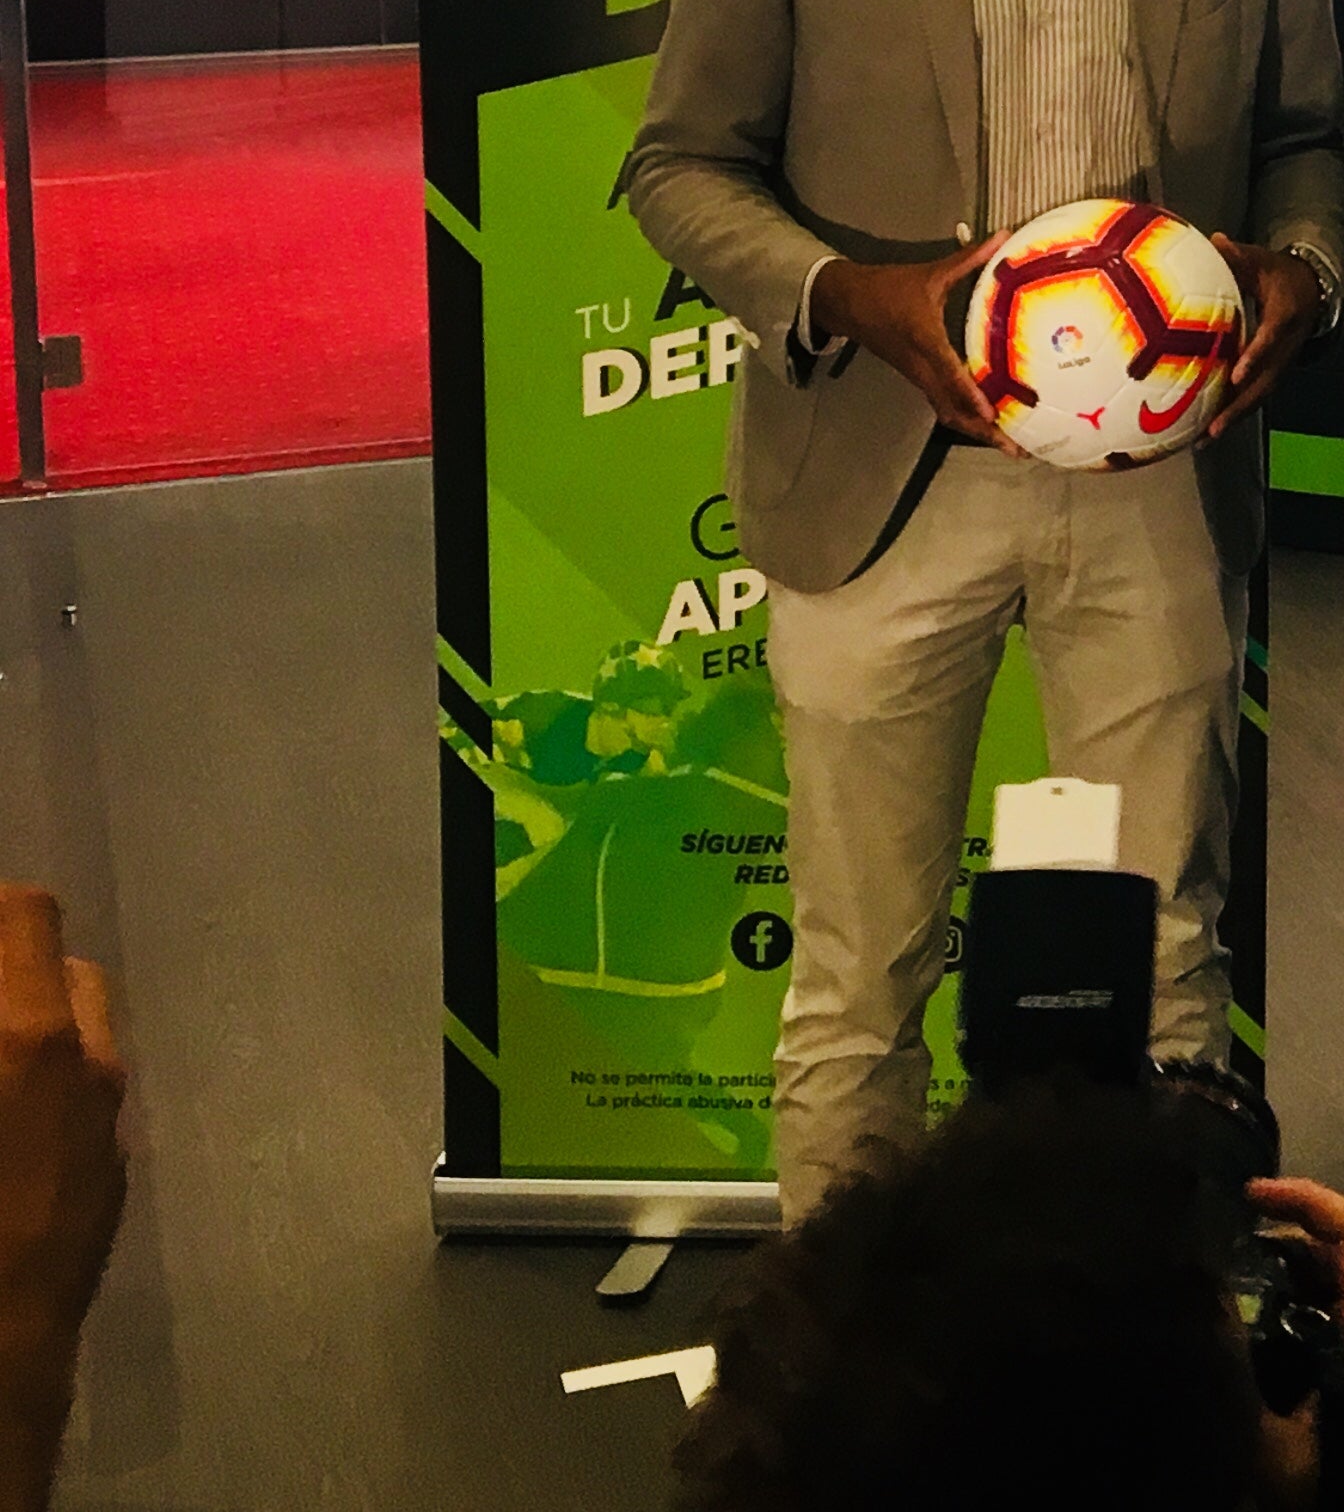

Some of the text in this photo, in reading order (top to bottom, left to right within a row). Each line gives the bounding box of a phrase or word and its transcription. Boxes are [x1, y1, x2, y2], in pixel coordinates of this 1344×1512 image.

[575, 298, 630, 339] TU
[680, 829, 788, 854] SÍGUEN
[735, 864, 789, 884] RED
[586, 1095, 606, 1108] La
[613, 1093, 682, 1110] práctica
[688, 1094, 753, 1109] abusiva
